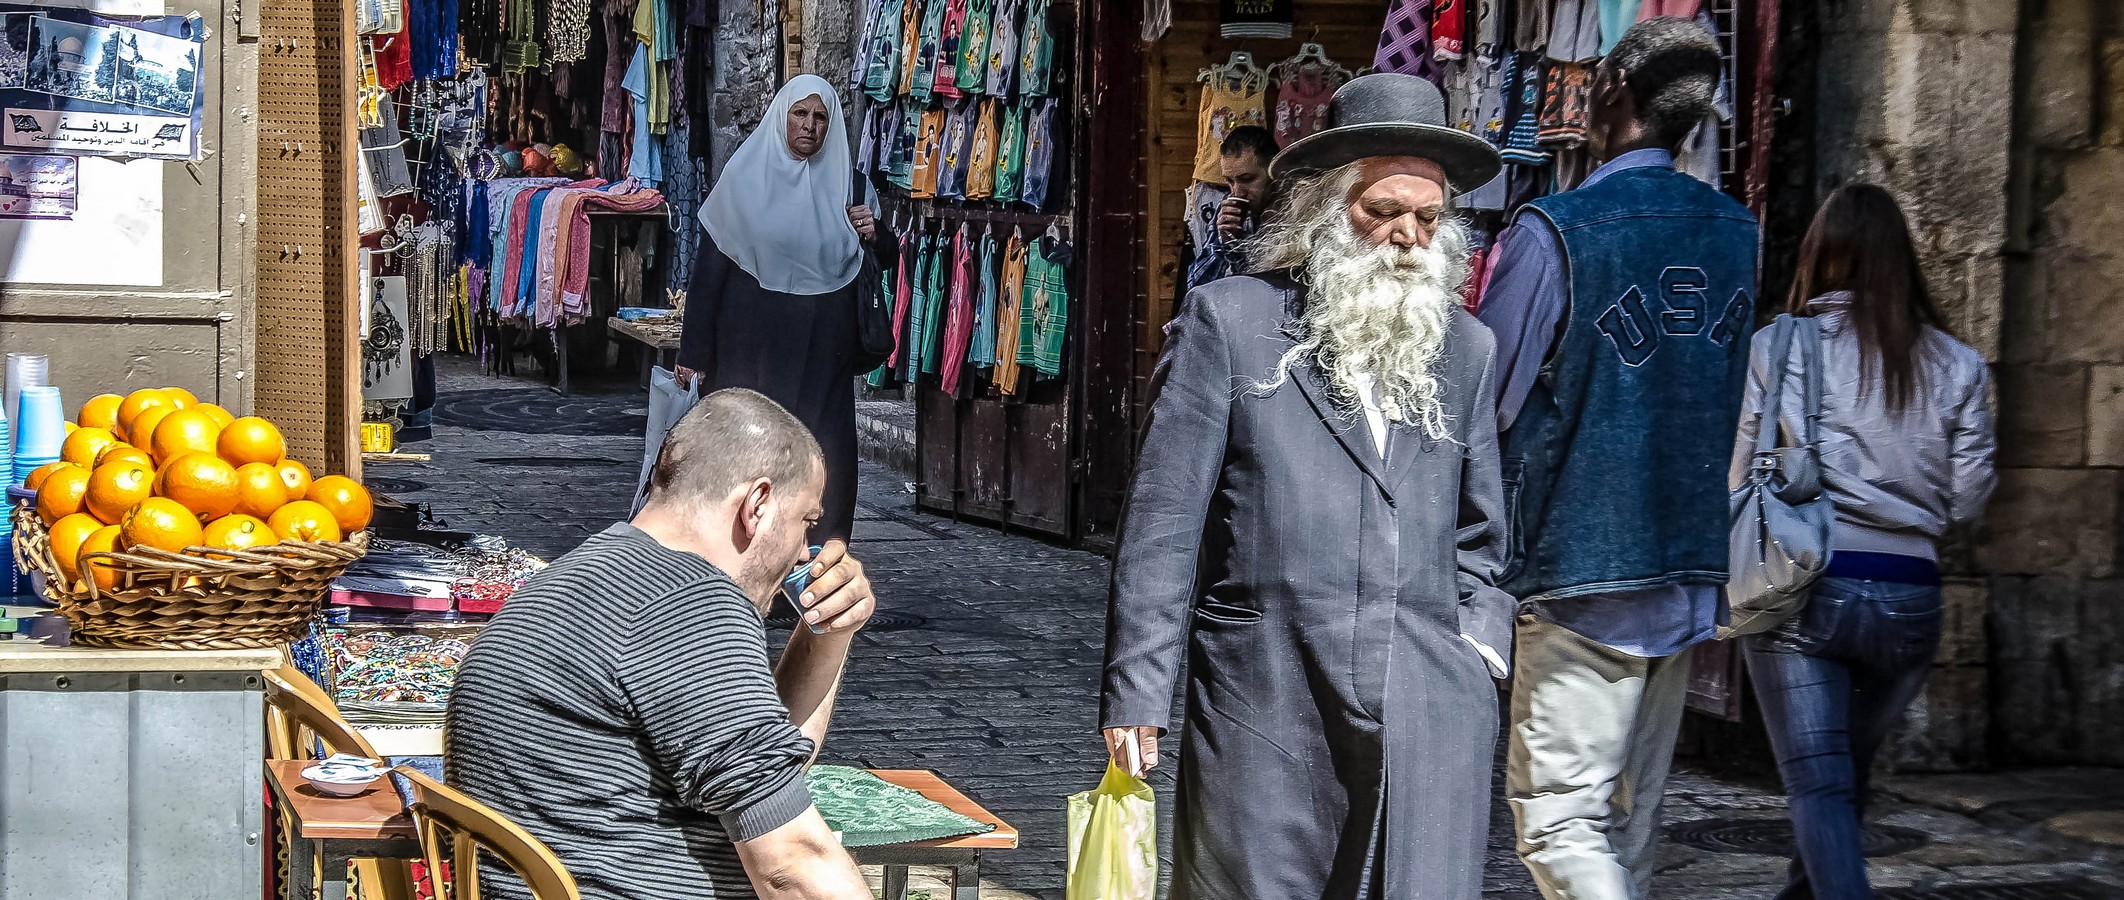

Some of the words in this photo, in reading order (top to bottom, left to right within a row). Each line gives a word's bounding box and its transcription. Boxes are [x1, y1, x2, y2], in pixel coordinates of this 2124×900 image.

[59, 116, 138, 134] الخلافة
[31, 133, 70, 142] المسلمين
[1594, 266, 1754, 367] USA
